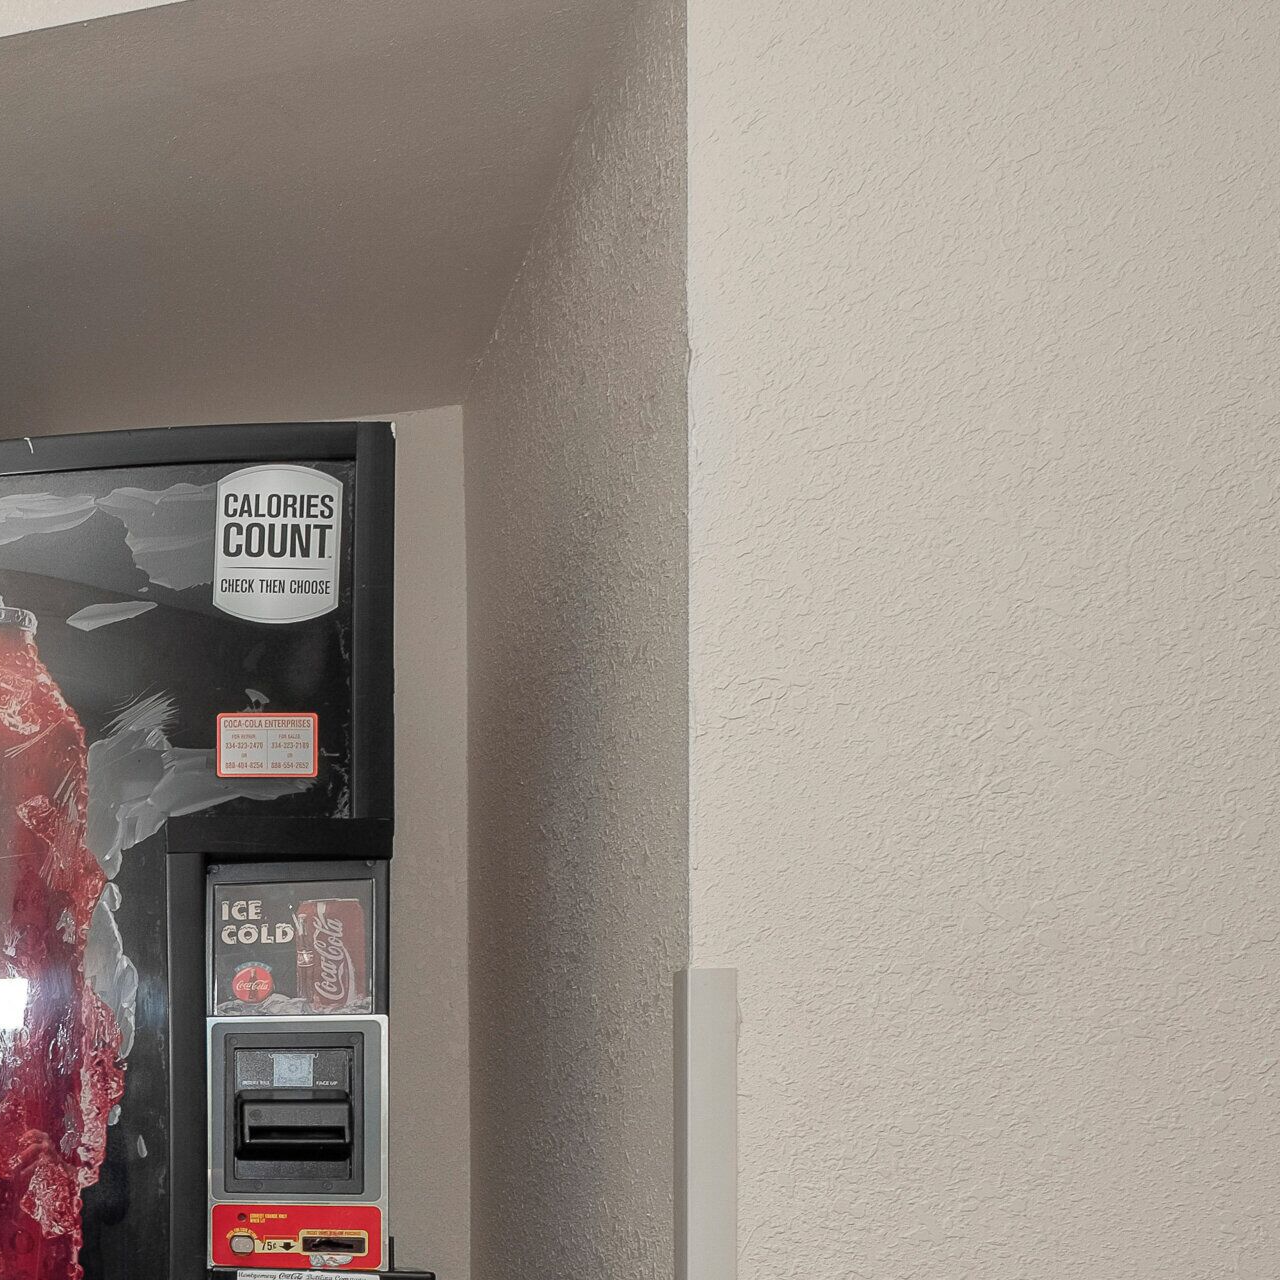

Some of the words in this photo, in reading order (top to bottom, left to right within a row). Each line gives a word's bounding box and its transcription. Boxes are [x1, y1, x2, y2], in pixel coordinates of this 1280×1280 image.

[223, 493, 335, 520] CALORIES
[220, 578, 254, 593] CHECK
[258, 578, 286, 594] THEN
[289, 579, 331, 595] CHOOSE
[223, 719, 263, 728] COCA-COLA
[264, 719, 311, 728] ENTERPRISES
[221, 900, 262, 921] ICE
[221, 923, 295, 945] COLD
[238, 1271, 277, 1280] Montgomery
